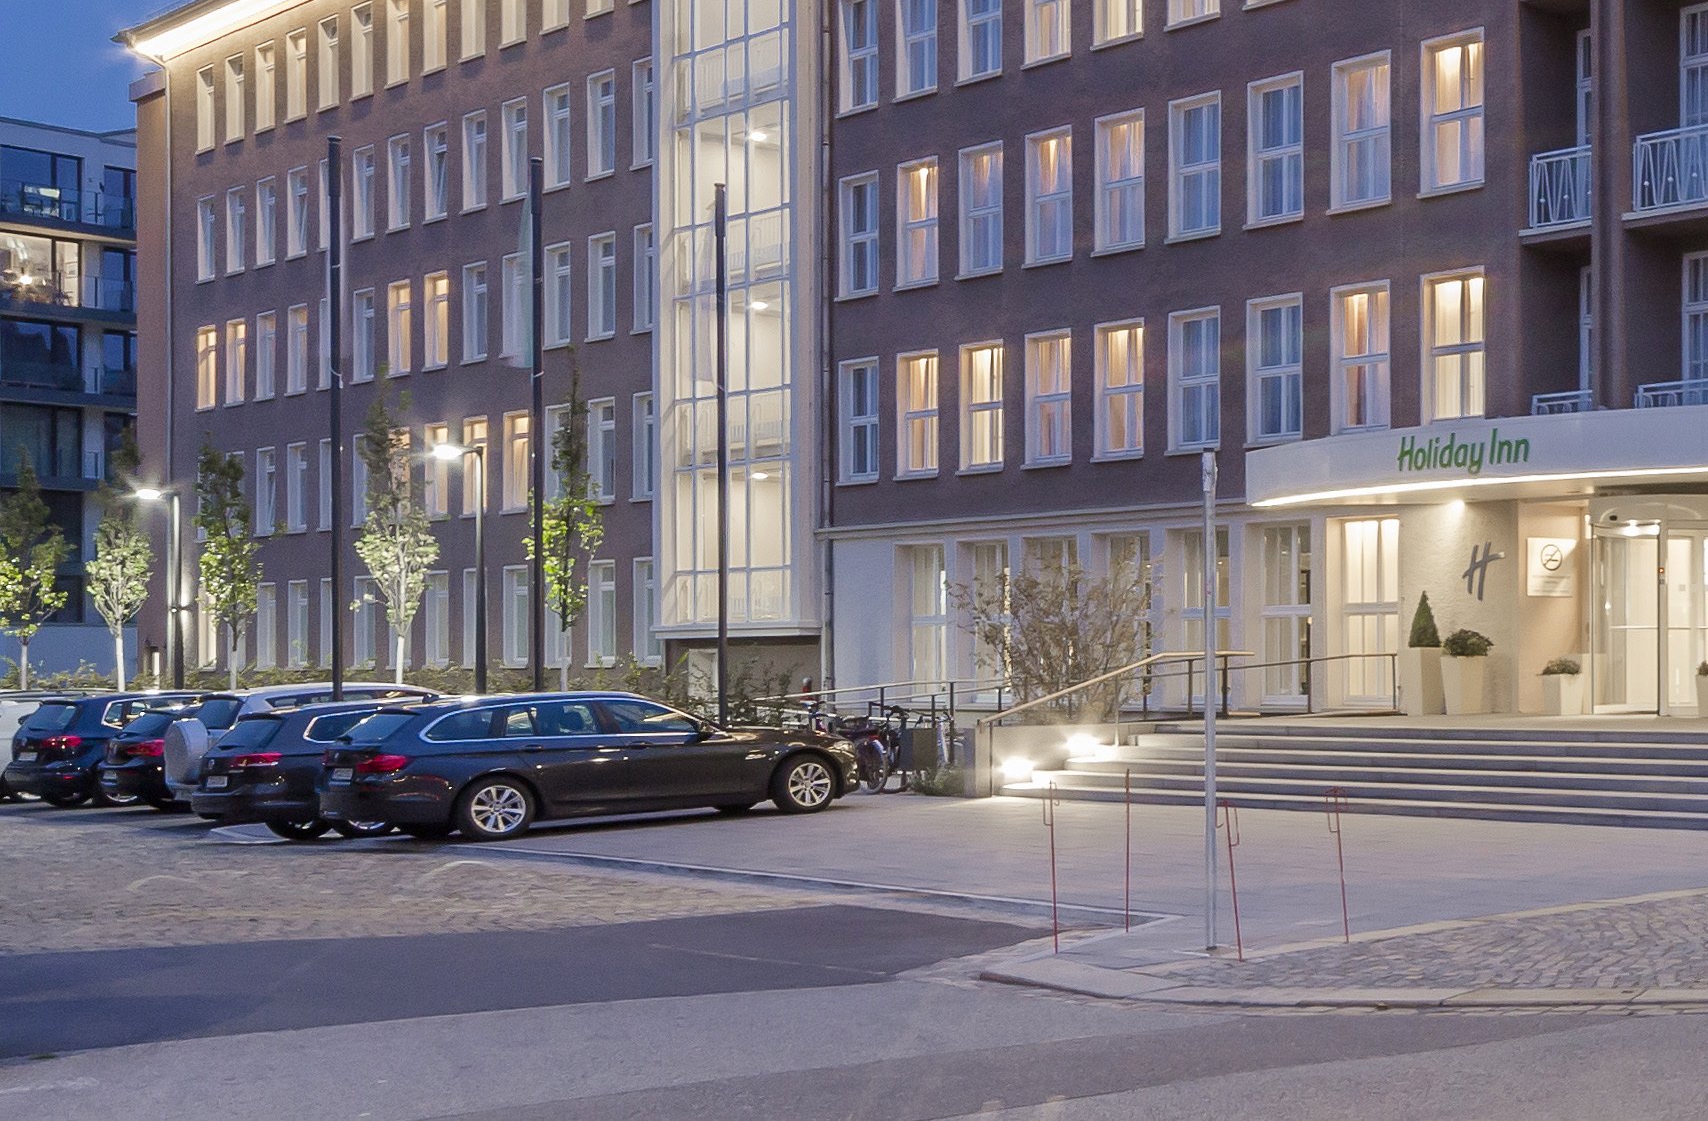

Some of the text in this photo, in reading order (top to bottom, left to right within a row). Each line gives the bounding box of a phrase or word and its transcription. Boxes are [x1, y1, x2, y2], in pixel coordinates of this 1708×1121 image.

[1397, 428, 1529, 474] Holiday Inn
[1461, 541, 1505, 601] H
